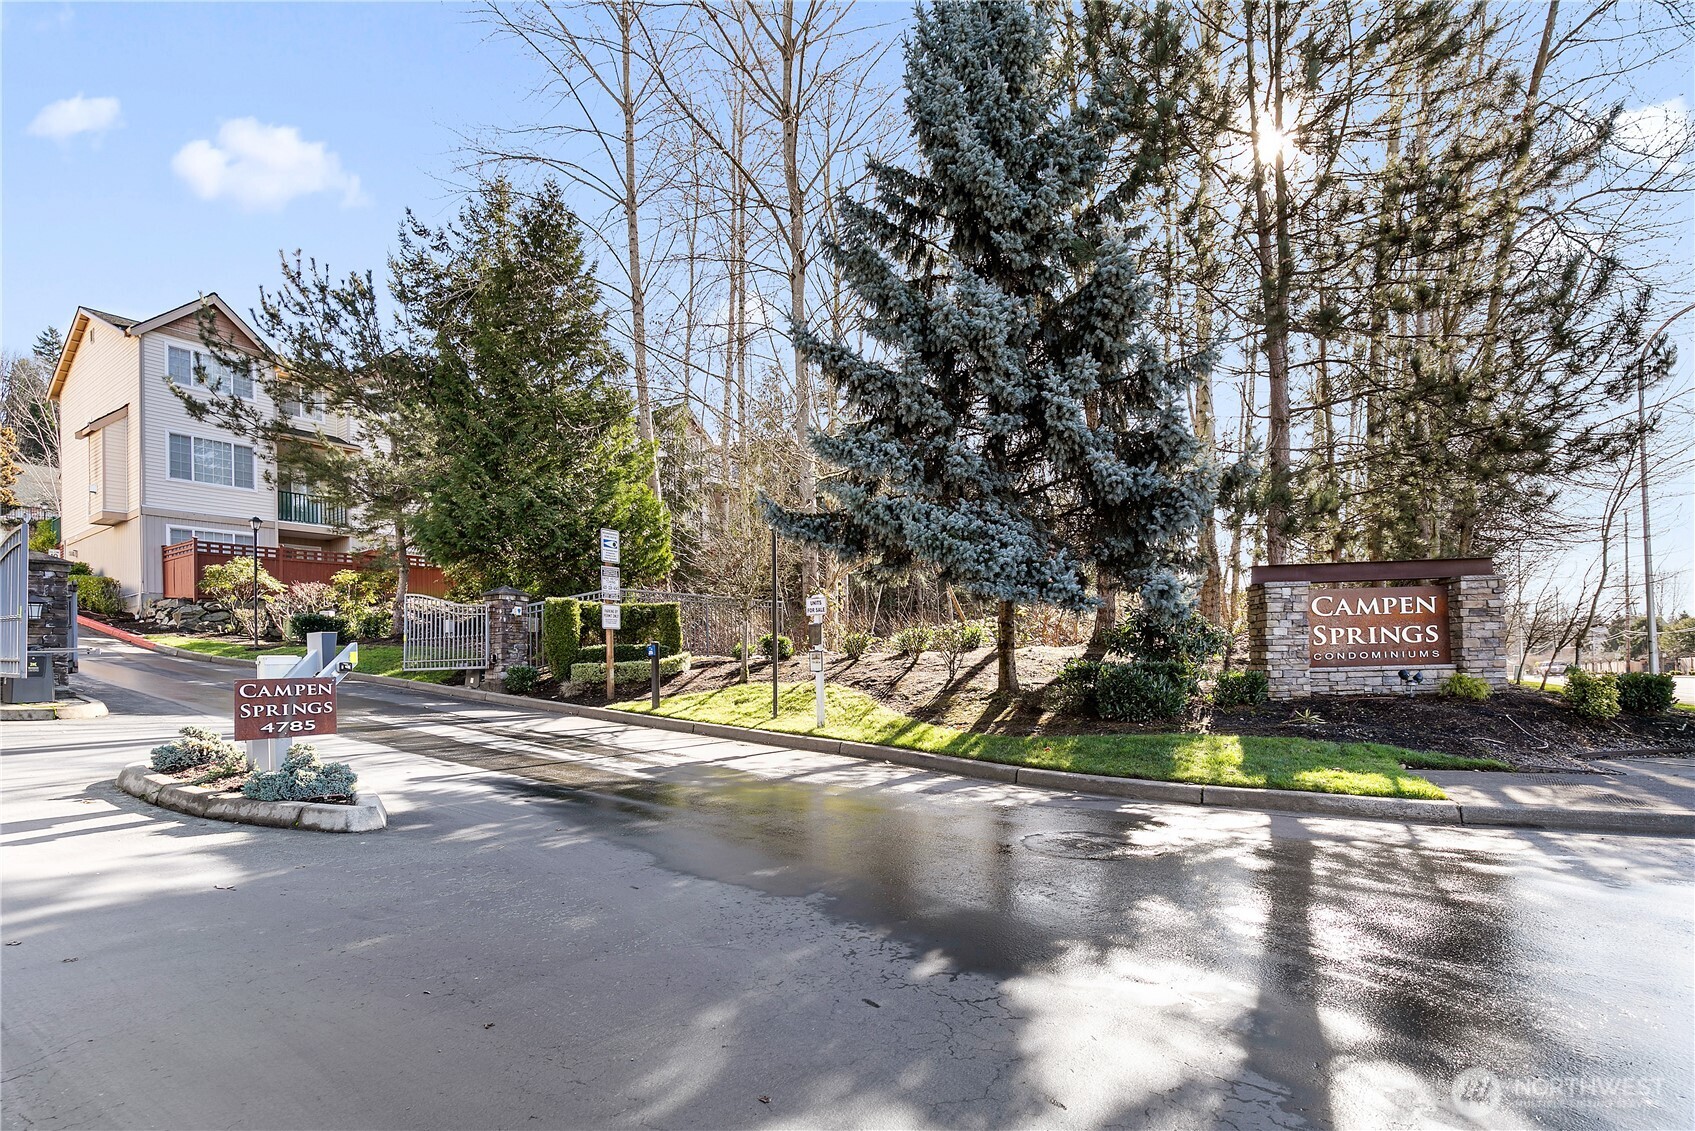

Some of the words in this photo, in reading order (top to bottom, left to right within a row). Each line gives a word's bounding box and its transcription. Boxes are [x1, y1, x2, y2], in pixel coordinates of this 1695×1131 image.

[1311, 596, 1436, 617] CAMPEN
[1313, 625, 1439, 646] SPRINGS
[1313, 650, 1440, 661] CONDOMINIUMS
[239, 683, 332, 698] CAMPEN
[240, 701, 333, 718] SPRINGS
[260, 720, 316, 733] 4785
